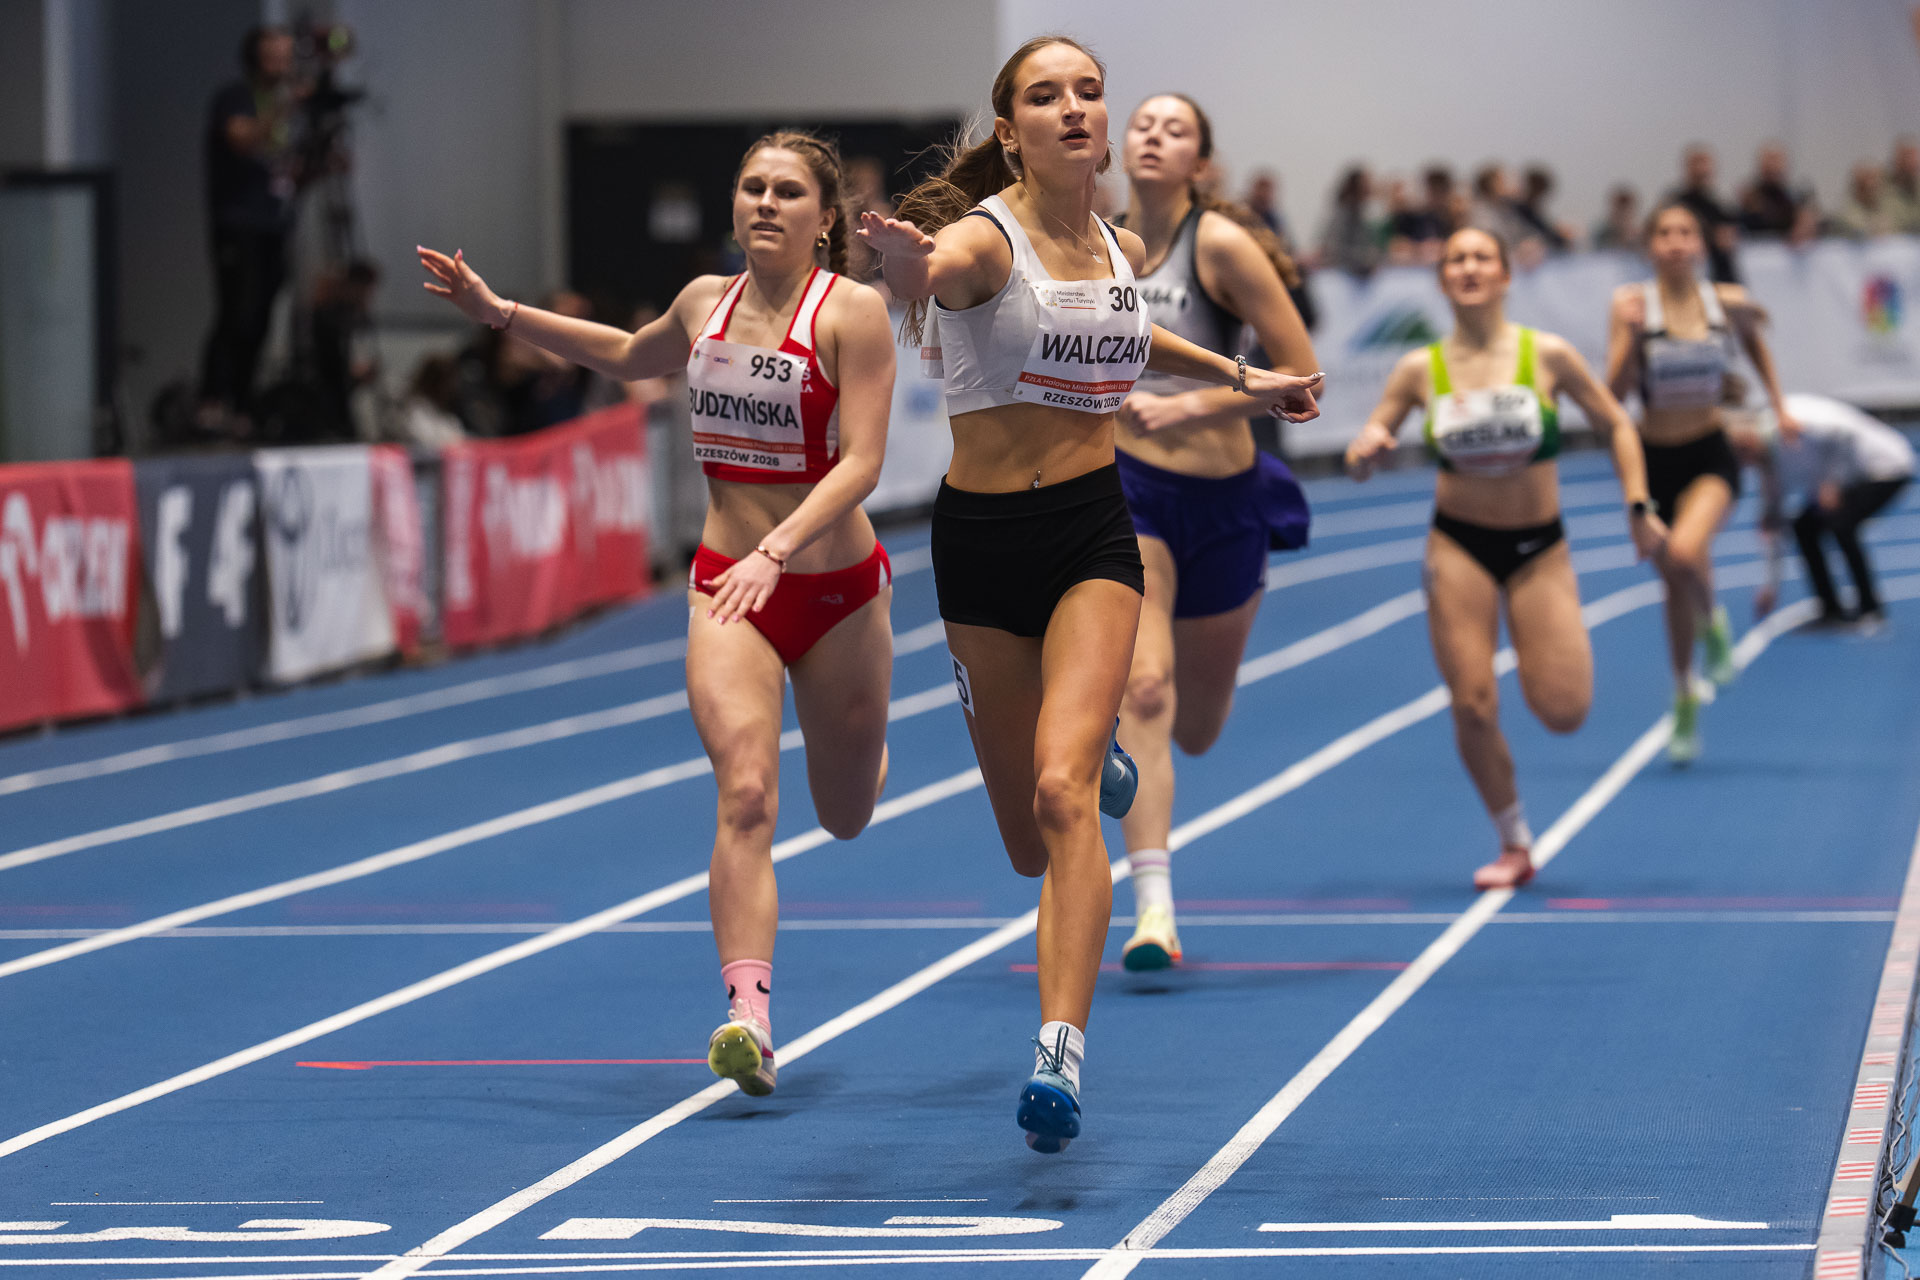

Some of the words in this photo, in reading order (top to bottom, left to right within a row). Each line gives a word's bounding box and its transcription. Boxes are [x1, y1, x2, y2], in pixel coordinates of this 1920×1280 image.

[1109, 286, 1140, 312] 30
[1041, 333, 1150, 364] WALCZAK
[750, 355, 792, 382] 953
[1024, 374, 1041, 384] PZLA
[1043, 378, 1071, 390] Halowe
[1043, 391, 1104, 409] RZESZÓW
[1104, 396, 1121, 408] 2026
[695, 448, 750, 463] RZESZÓW
[752, 454, 780, 467] 2026
